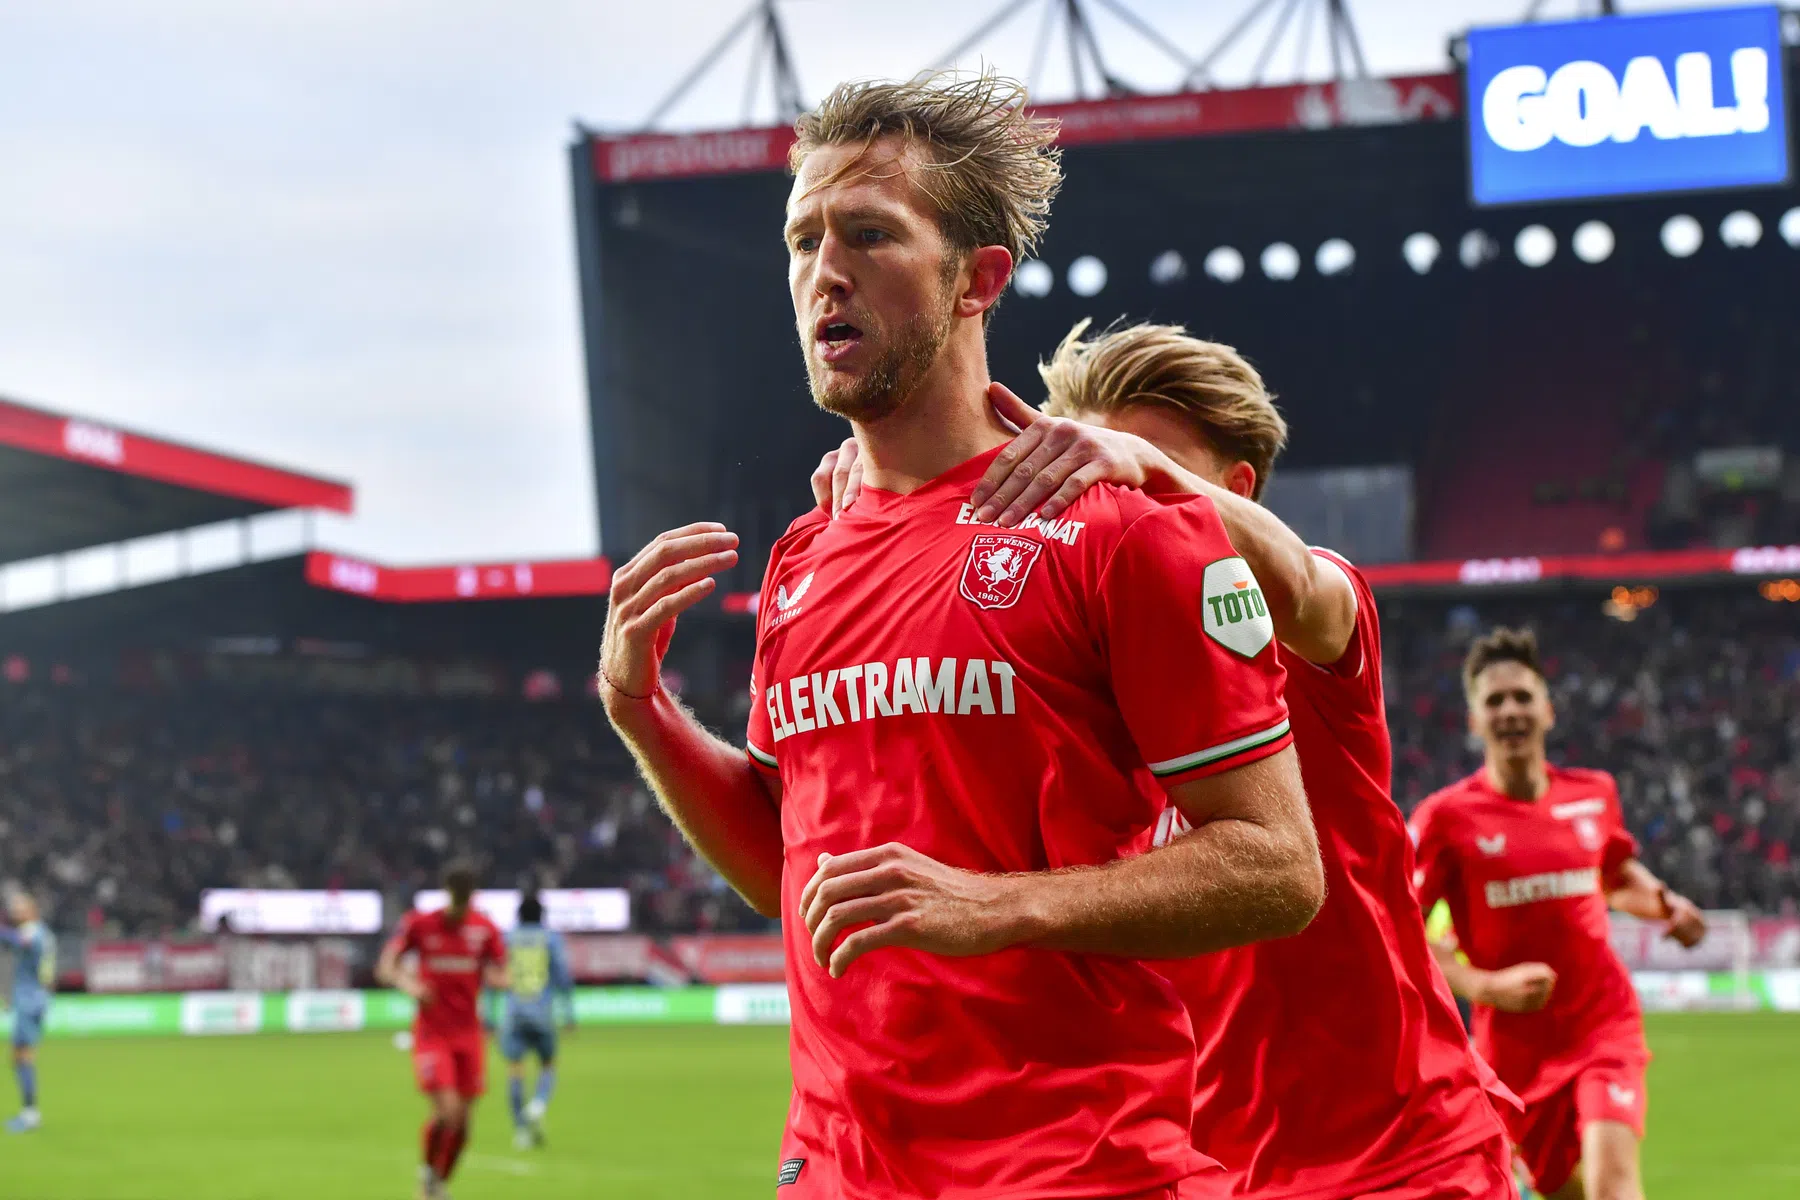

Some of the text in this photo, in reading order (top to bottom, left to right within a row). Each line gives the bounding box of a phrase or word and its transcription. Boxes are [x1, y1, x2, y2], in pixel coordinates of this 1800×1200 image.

[1482, 47, 1769, 151] GOAL!
[997, 537, 1037, 552] TWENTE
[977, 591, 999, 602] 1965
[1207, 588, 1266, 626] TOTO
[766, 657, 1017, 743] ELEKTRAMAT
